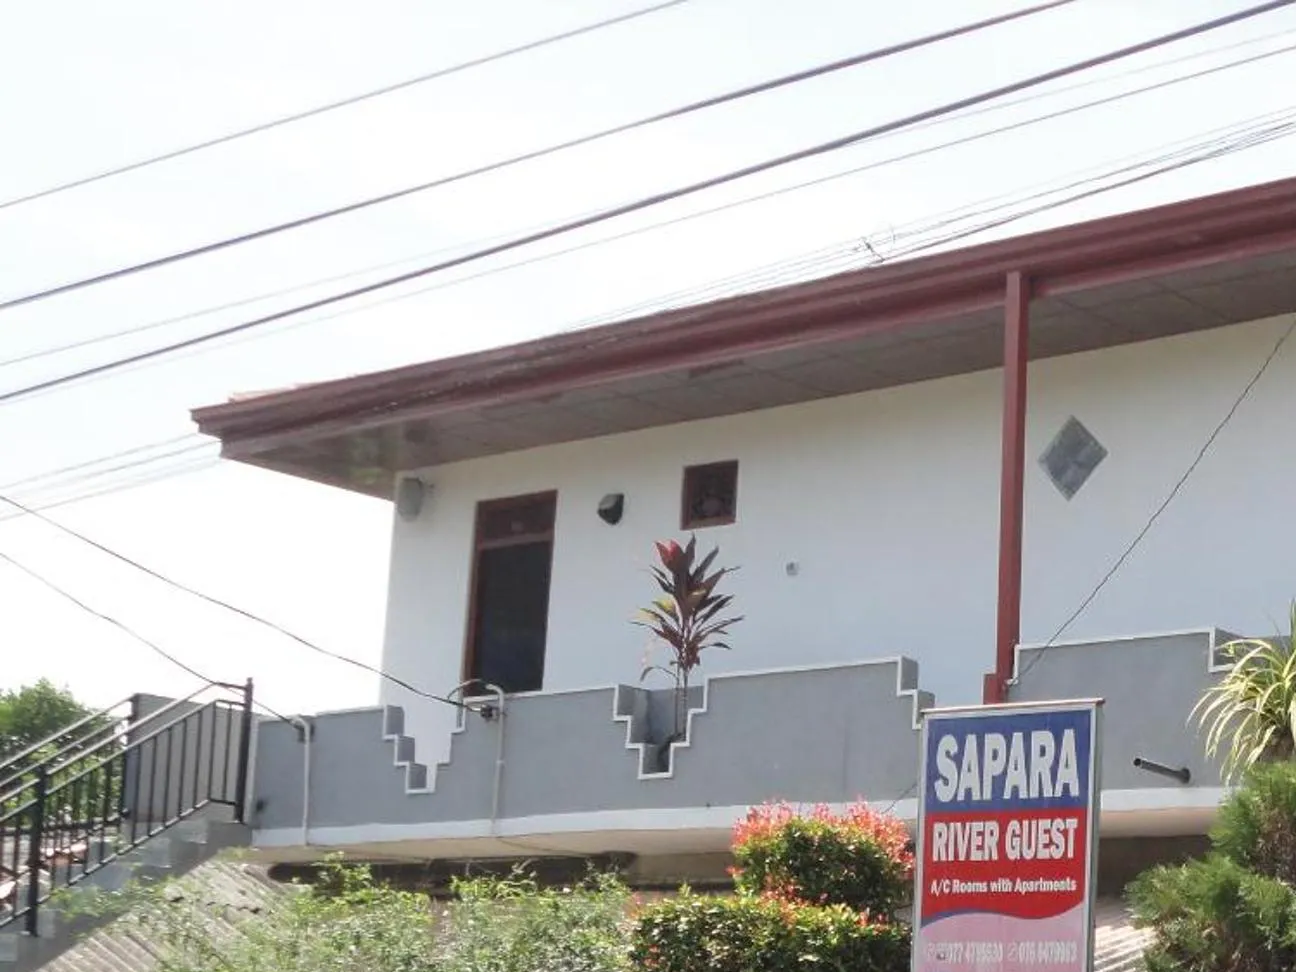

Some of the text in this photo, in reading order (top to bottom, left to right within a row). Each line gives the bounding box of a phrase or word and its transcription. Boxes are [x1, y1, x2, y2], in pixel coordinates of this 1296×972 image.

[934, 729, 1079, 802] SAPARA
[932, 818, 1078, 862] RIVER GUEST
[930, 877, 1076, 896] A/C Rooms with Apartments
